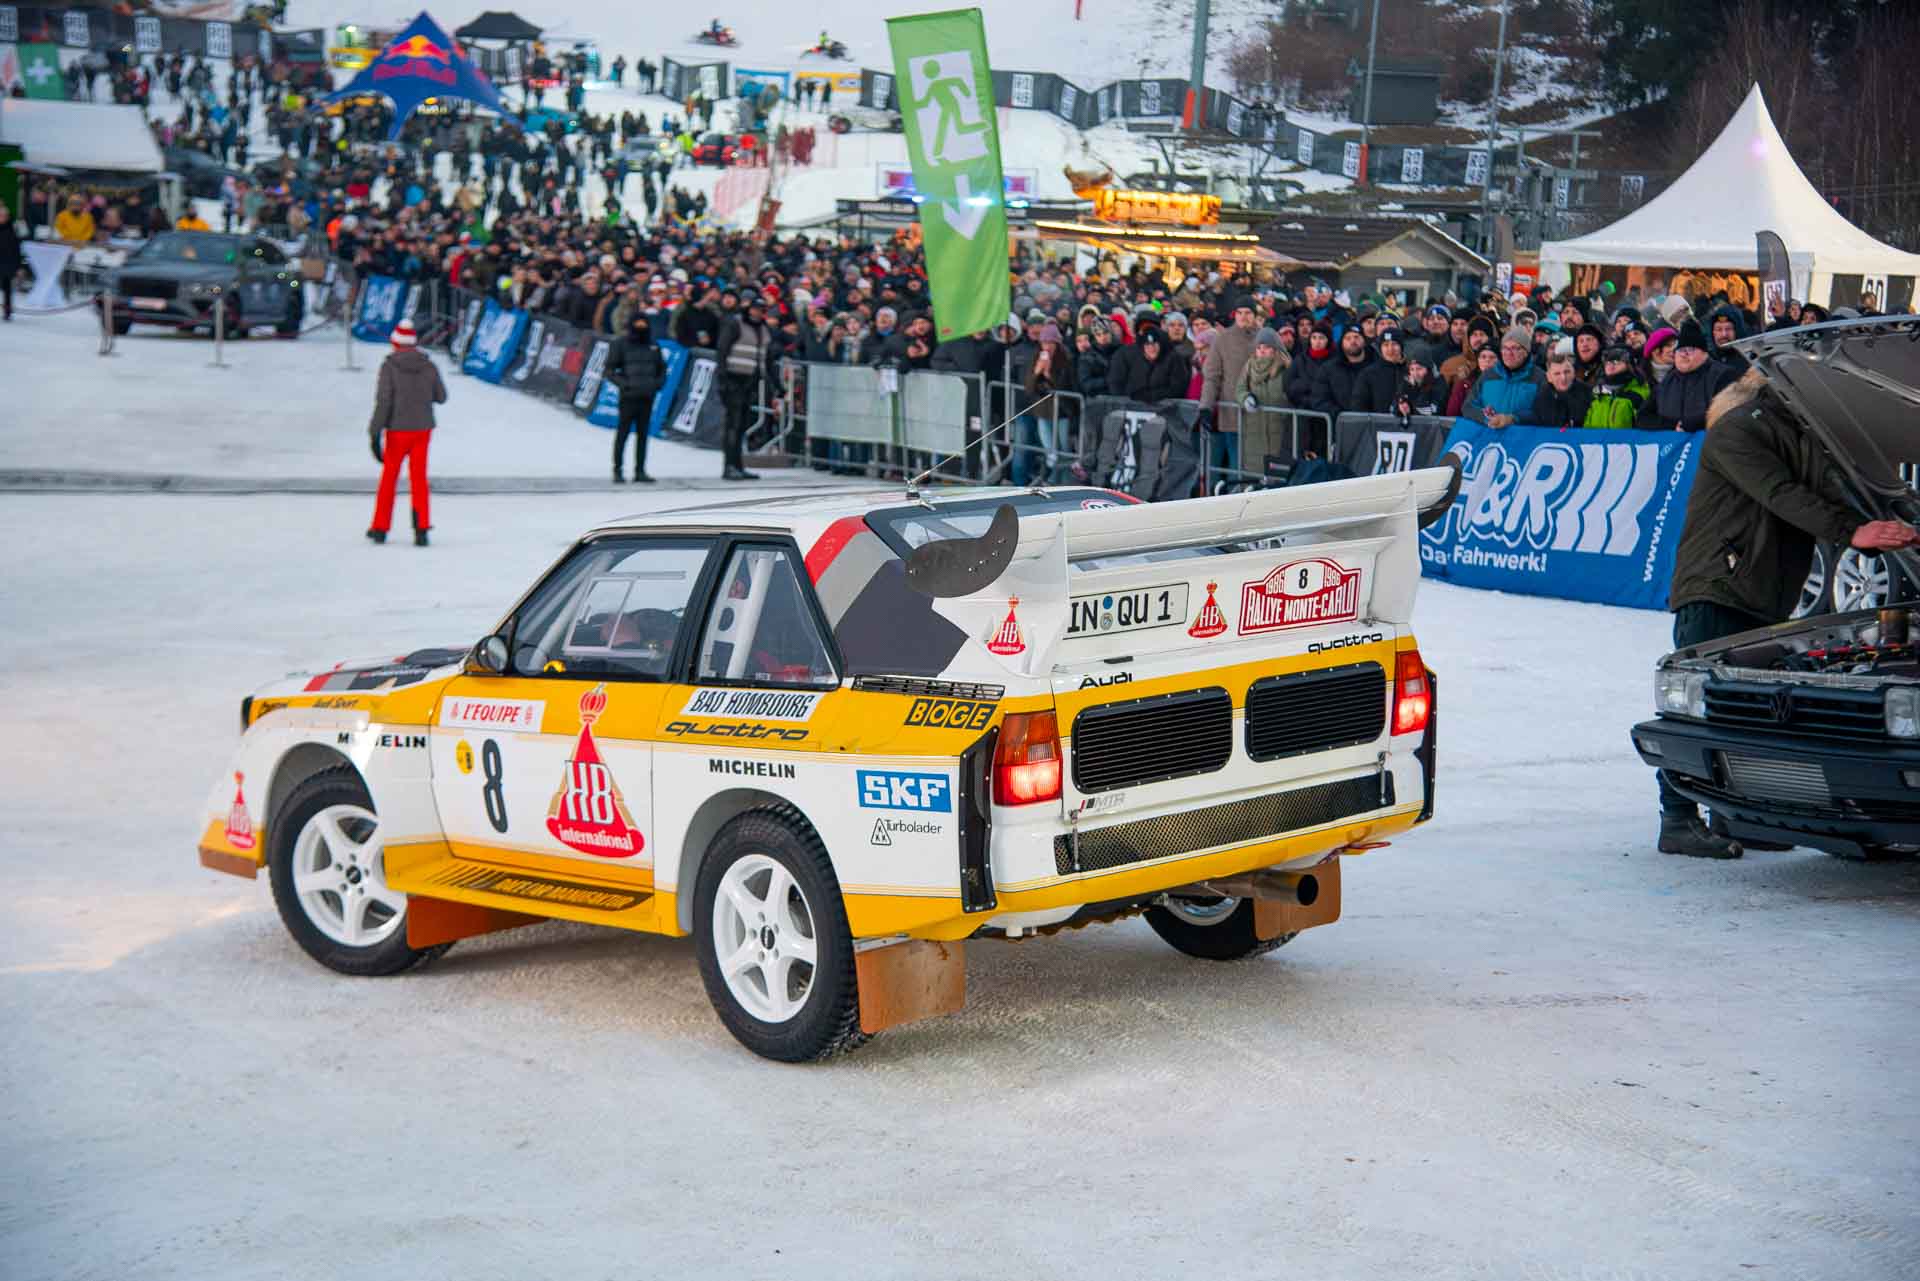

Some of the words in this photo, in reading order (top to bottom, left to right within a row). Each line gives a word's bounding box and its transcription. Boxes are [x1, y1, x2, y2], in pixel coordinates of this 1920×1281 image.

[1643, 441, 1692, 582] www.h-r.com
[1421, 544, 1452, 565] Da
[1453, 545, 1547, 573] Fahrwerk!
[1298, 568, 1309, 588] 8
[1067, 601, 1098, 633] IN
[1117, 594, 1149, 626] QU
[1157, 590, 1171, 621] 1
[1245, 588, 1283, 626] RALLYE
[1284, 577, 1355, 622] MONTE-CARLO
[1199, 605, 1219, 627] HB
[998, 621, 1018, 643] HB
[1308, 632, 1383, 654] quattro
[1078, 672, 1133, 689] Audi
[462, 703, 521, 723] L'EQUIPE
[690, 690, 727, 713] BAD
[723, 692, 815, 717] HOMBOURG
[907, 699, 995, 729] BOGE
[665, 720, 809, 740] quattro
[709, 758, 796, 779] MICHELIN
[482, 738, 508, 833] 8
[564, 760, 615, 826] HB
[863, 775, 946, 808] SKF
[558, 824, 634, 851] international
[884, 819, 943, 834] Turbolader
